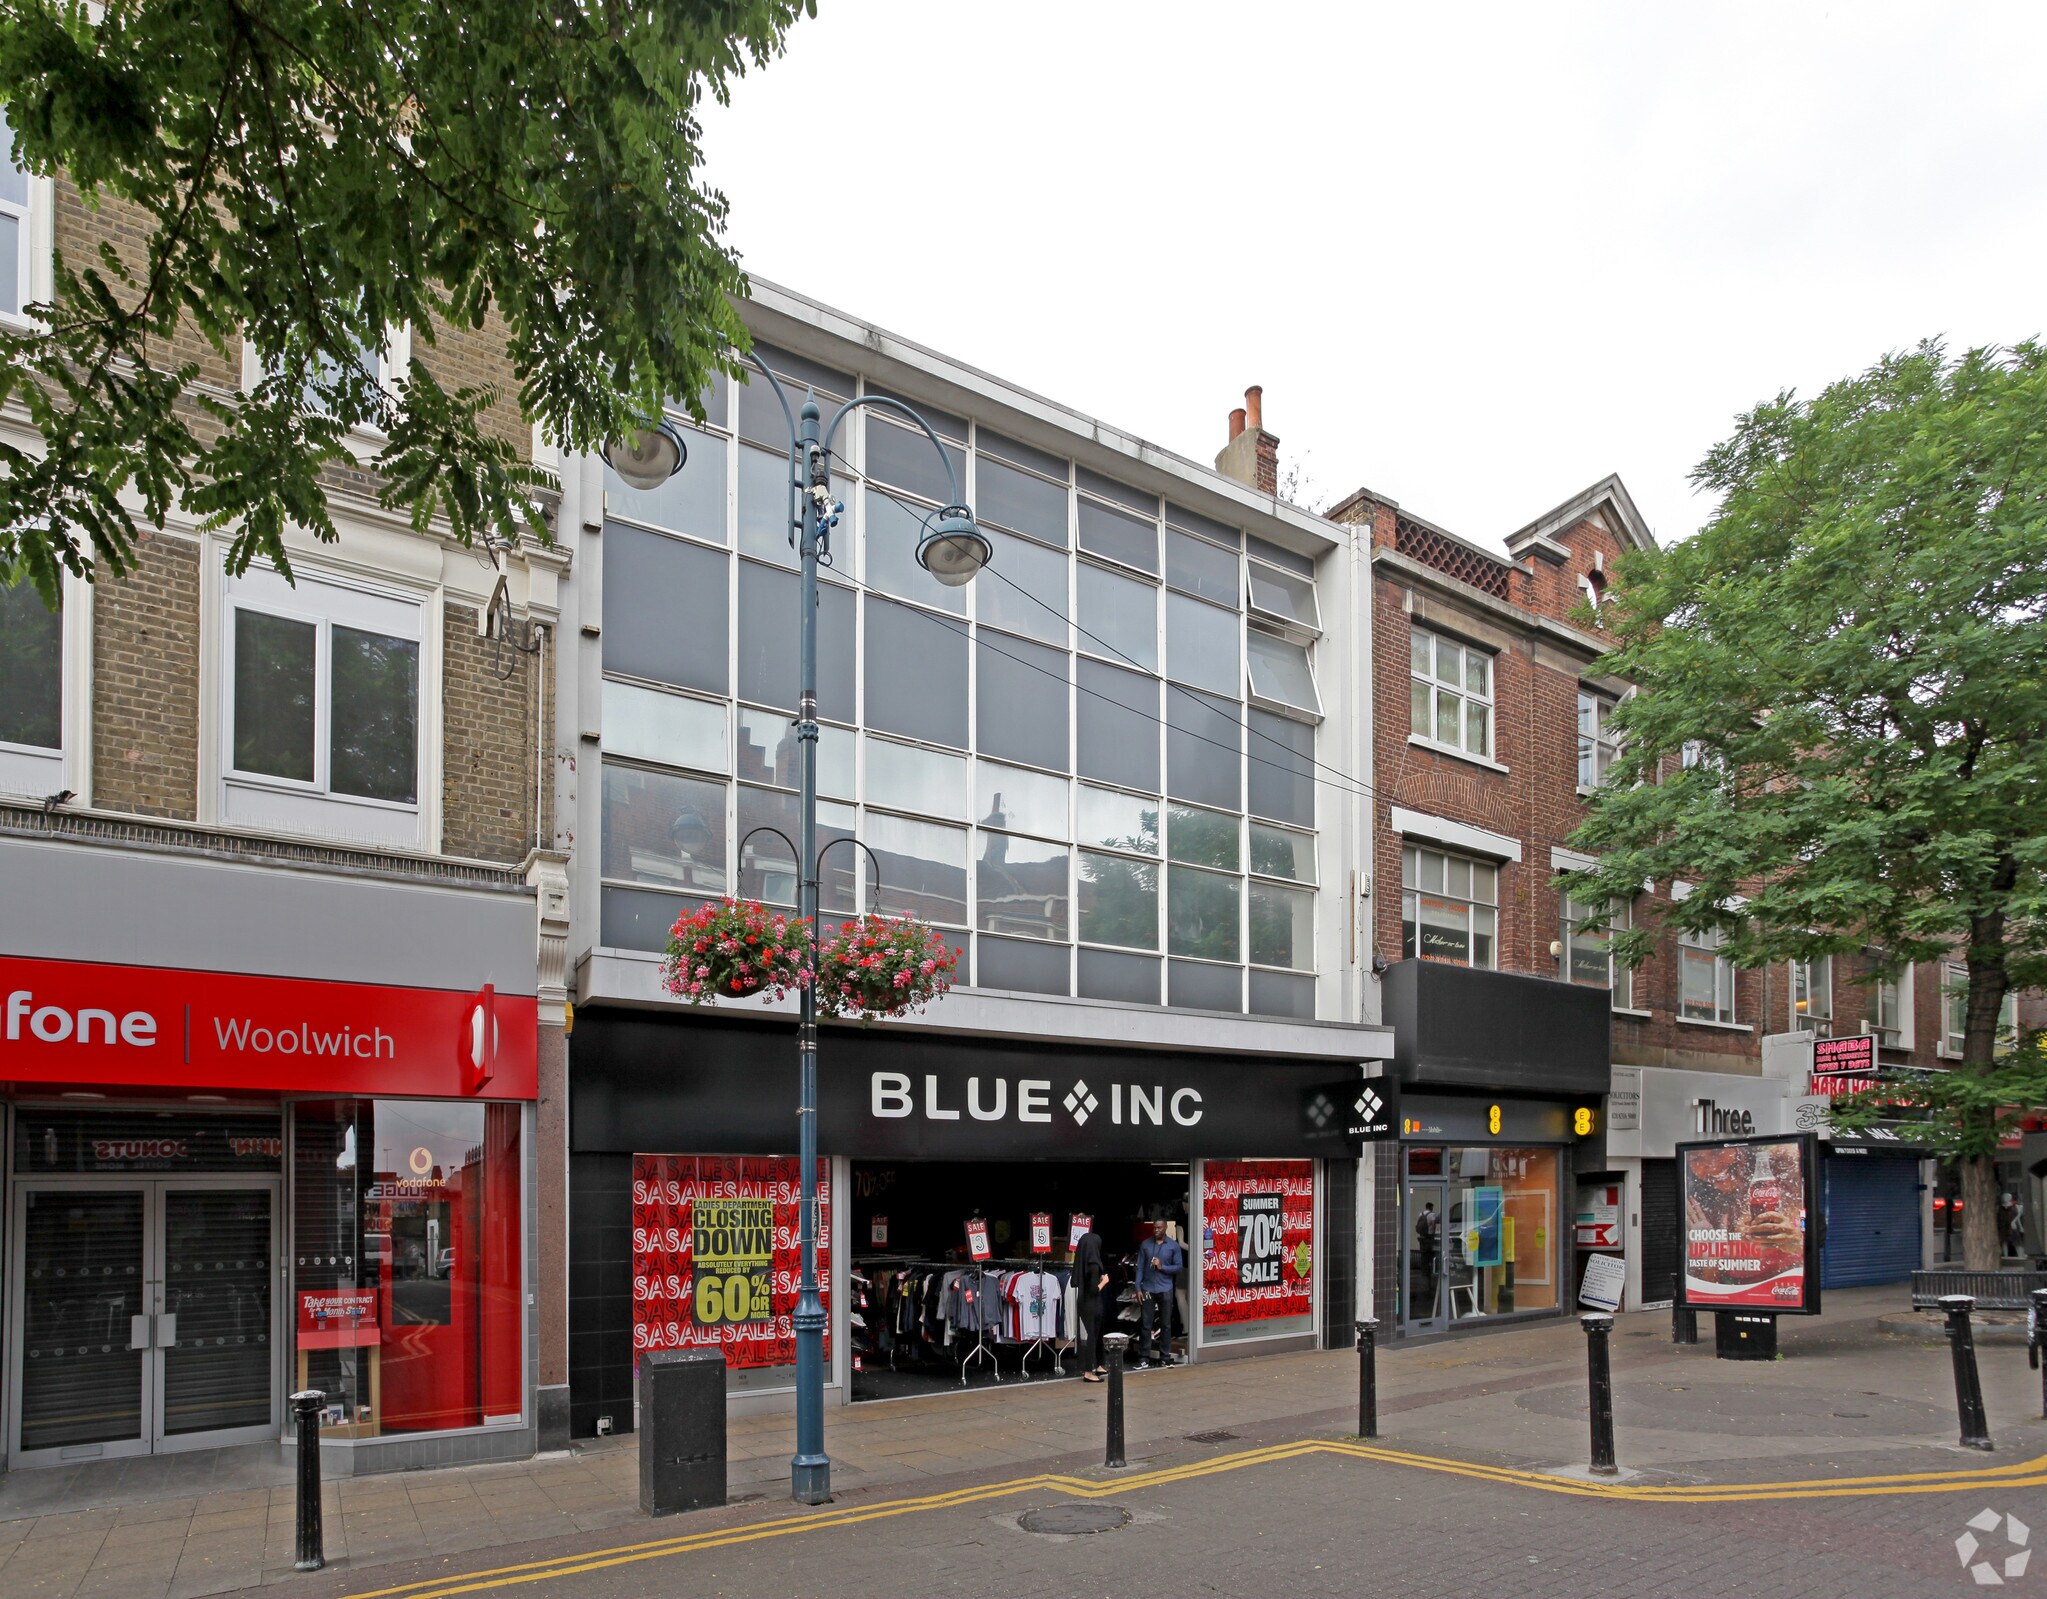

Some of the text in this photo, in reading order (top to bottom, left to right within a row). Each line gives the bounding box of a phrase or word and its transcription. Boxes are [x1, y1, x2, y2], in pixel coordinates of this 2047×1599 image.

[0, 990, 395, 1059] fone Woolwich
[1817, 1038, 1870, 1055] SHABA
[871, 1071, 1204, 1126] BLUE INC
[1348, 1126, 1371, 1134] BLUE
[1372, 1124, 1388, 1132] INC
[396, 1176, 446, 1188] vodafone
[693, 1201, 772, 1209] LADIES DEPARTMENT
[1243, 1198, 1279, 1210] SUMMER
[693, 1209, 772, 1229] CLOSING
[1032, 1216, 1049, 1224] SALE
[1072, 1216, 1090, 1226] SALE
[967, 1222, 985, 1232] SALE
[1037, 1228, 1047, 1245] 5
[1688, 1229, 1742, 1241] CHOOSE THE
[693, 1228, 772, 1257] DOWN
[975, 1235, 985, 1251] 3
[1269, 1240, 1282, 1256] OFF
[1689, 1241, 1762, 1259] UPLIFTING
[697, 1260, 768, 1269] ABSOLUTELY EVERYTHING
[1688, 1259, 1761, 1271] TASTE OF SUMMER
[1242, 1261, 1279, 1284] SALE
[303, 1295, 325, 1308] Take
[343, 1296, 374, 1304] CONTRACT
[751, 1296, 770, 1311] OR
[750, 1311, 770, 1319] MORE
